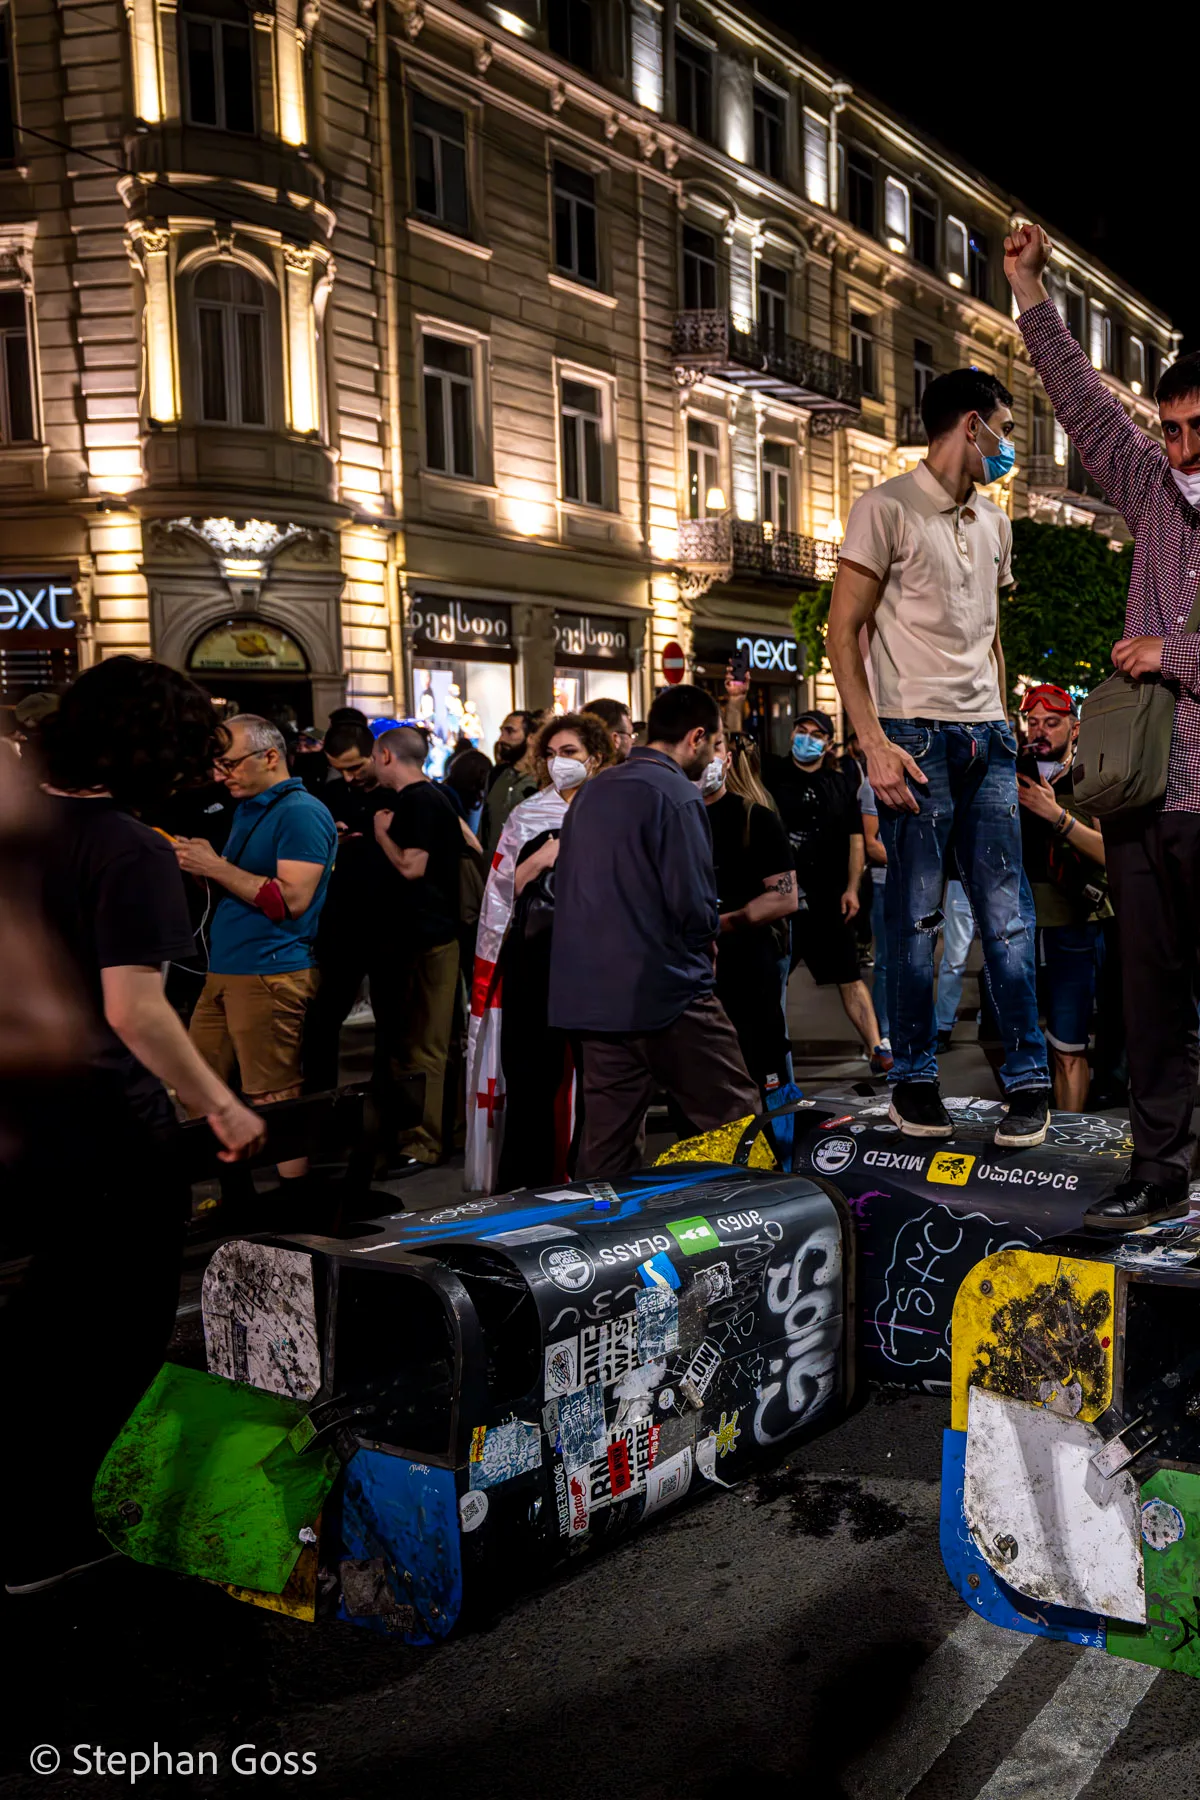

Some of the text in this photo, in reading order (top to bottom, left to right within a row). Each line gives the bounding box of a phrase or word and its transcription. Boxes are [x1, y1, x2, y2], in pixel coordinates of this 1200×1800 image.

[736, 637, 797, 672] next
[863, 1150, 925, 1172] MIXED
[978, 1165, 1079, 1191] შერეული
[716, 1209, 763, 1234] მინა
[598, 1233, 671, 1266] GLASS
[701, 1362, 717, 1386] MOON
[573, 1494, 589, 1531] Ratto
